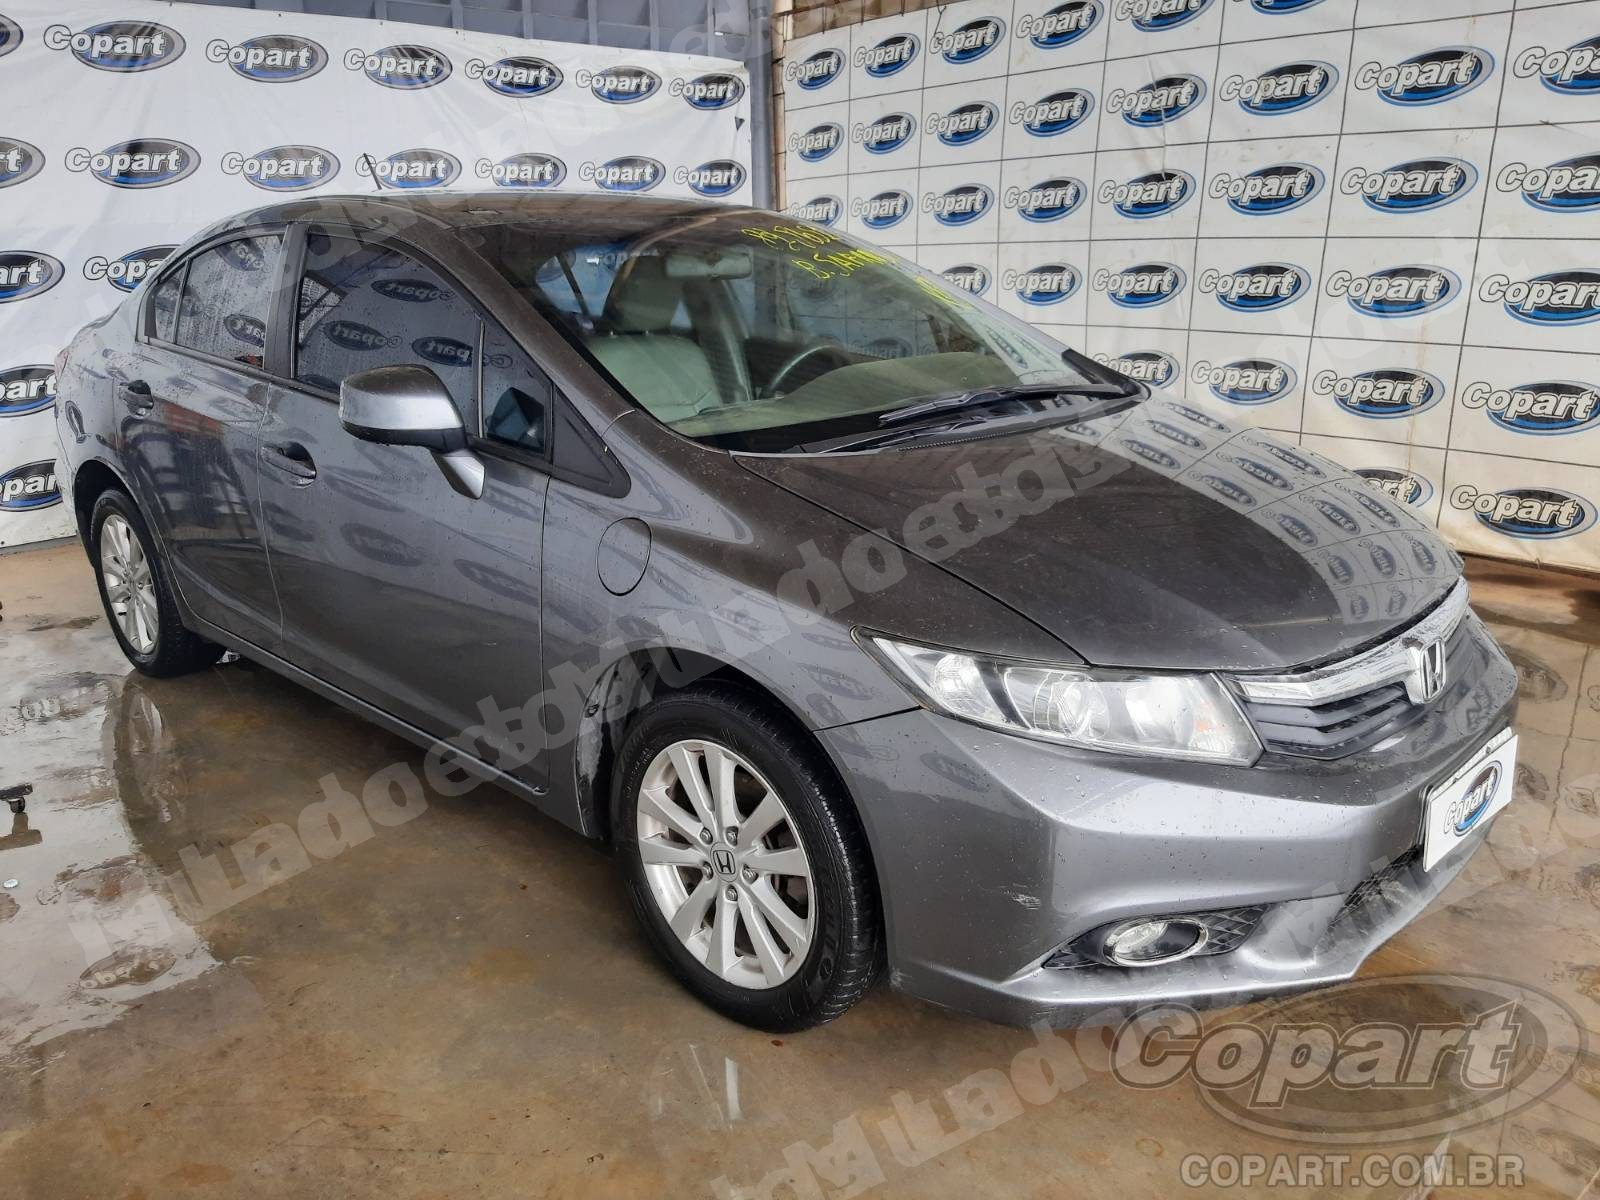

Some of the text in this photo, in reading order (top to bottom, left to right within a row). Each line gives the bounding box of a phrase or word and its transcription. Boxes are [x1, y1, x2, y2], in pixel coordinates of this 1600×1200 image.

[929, 21, 998, 54] Copart
[1016, 3, 1093, 42] Copart
[44, 24, 166, 58] Copart
[206, 39, 312, 69] Copart
[853, 36, 913, 69] Copart
[344, 48, 439, 77] Copart
[464, 58, 551, 87] Copart
[786, 50, 838, 82] Copart
[1355, 51, 1477, 96] Copart
[576, 69, 651, 95] Copart
[668, 78, 735, 100] Copart
[1106, 79, 1195, 118] Copart
[1220, 66, 1325, 106] Copart
[925, 106, 991, 139] Copart
[1009, 93, 1084, 129] Copart
[788, 125, 836, 156] Copart
[852, 118, 909, 148] Copart
[65, 147, 181, 177] Copart
[221, 152, 323, 180] Copart
[355, 155, 447, 182] Copart
[475, 158, 554, 184] Copart
[579, 161, 653, 187] Copart
[673, 166, 738, 190] Copart
[1098, 174, 1185, 210] Copart
[1208, 170, 1311, 206] Copart
[1340, 164, 1460, 202] Copart
[1496, 162, 1600, 200] Copa
[851, 193, 907, 222] Copart
[921, 188, 985, 219] Copart
[1004, 183, 1080, 214] Copart
[1002, 268, 1074, 302] Copart
[1092, 267, 1178, 302] Copart
[1199, 268, 1301, 302] Copart
[1325, 270, 1445, 304] Copart
[1191, 360, 1284, 394] Copart
[1312, 369, 1428, 405] Copart
[1462, 382, 1600, 421] Copart
[1450, 485, 1577, 527] Copart
